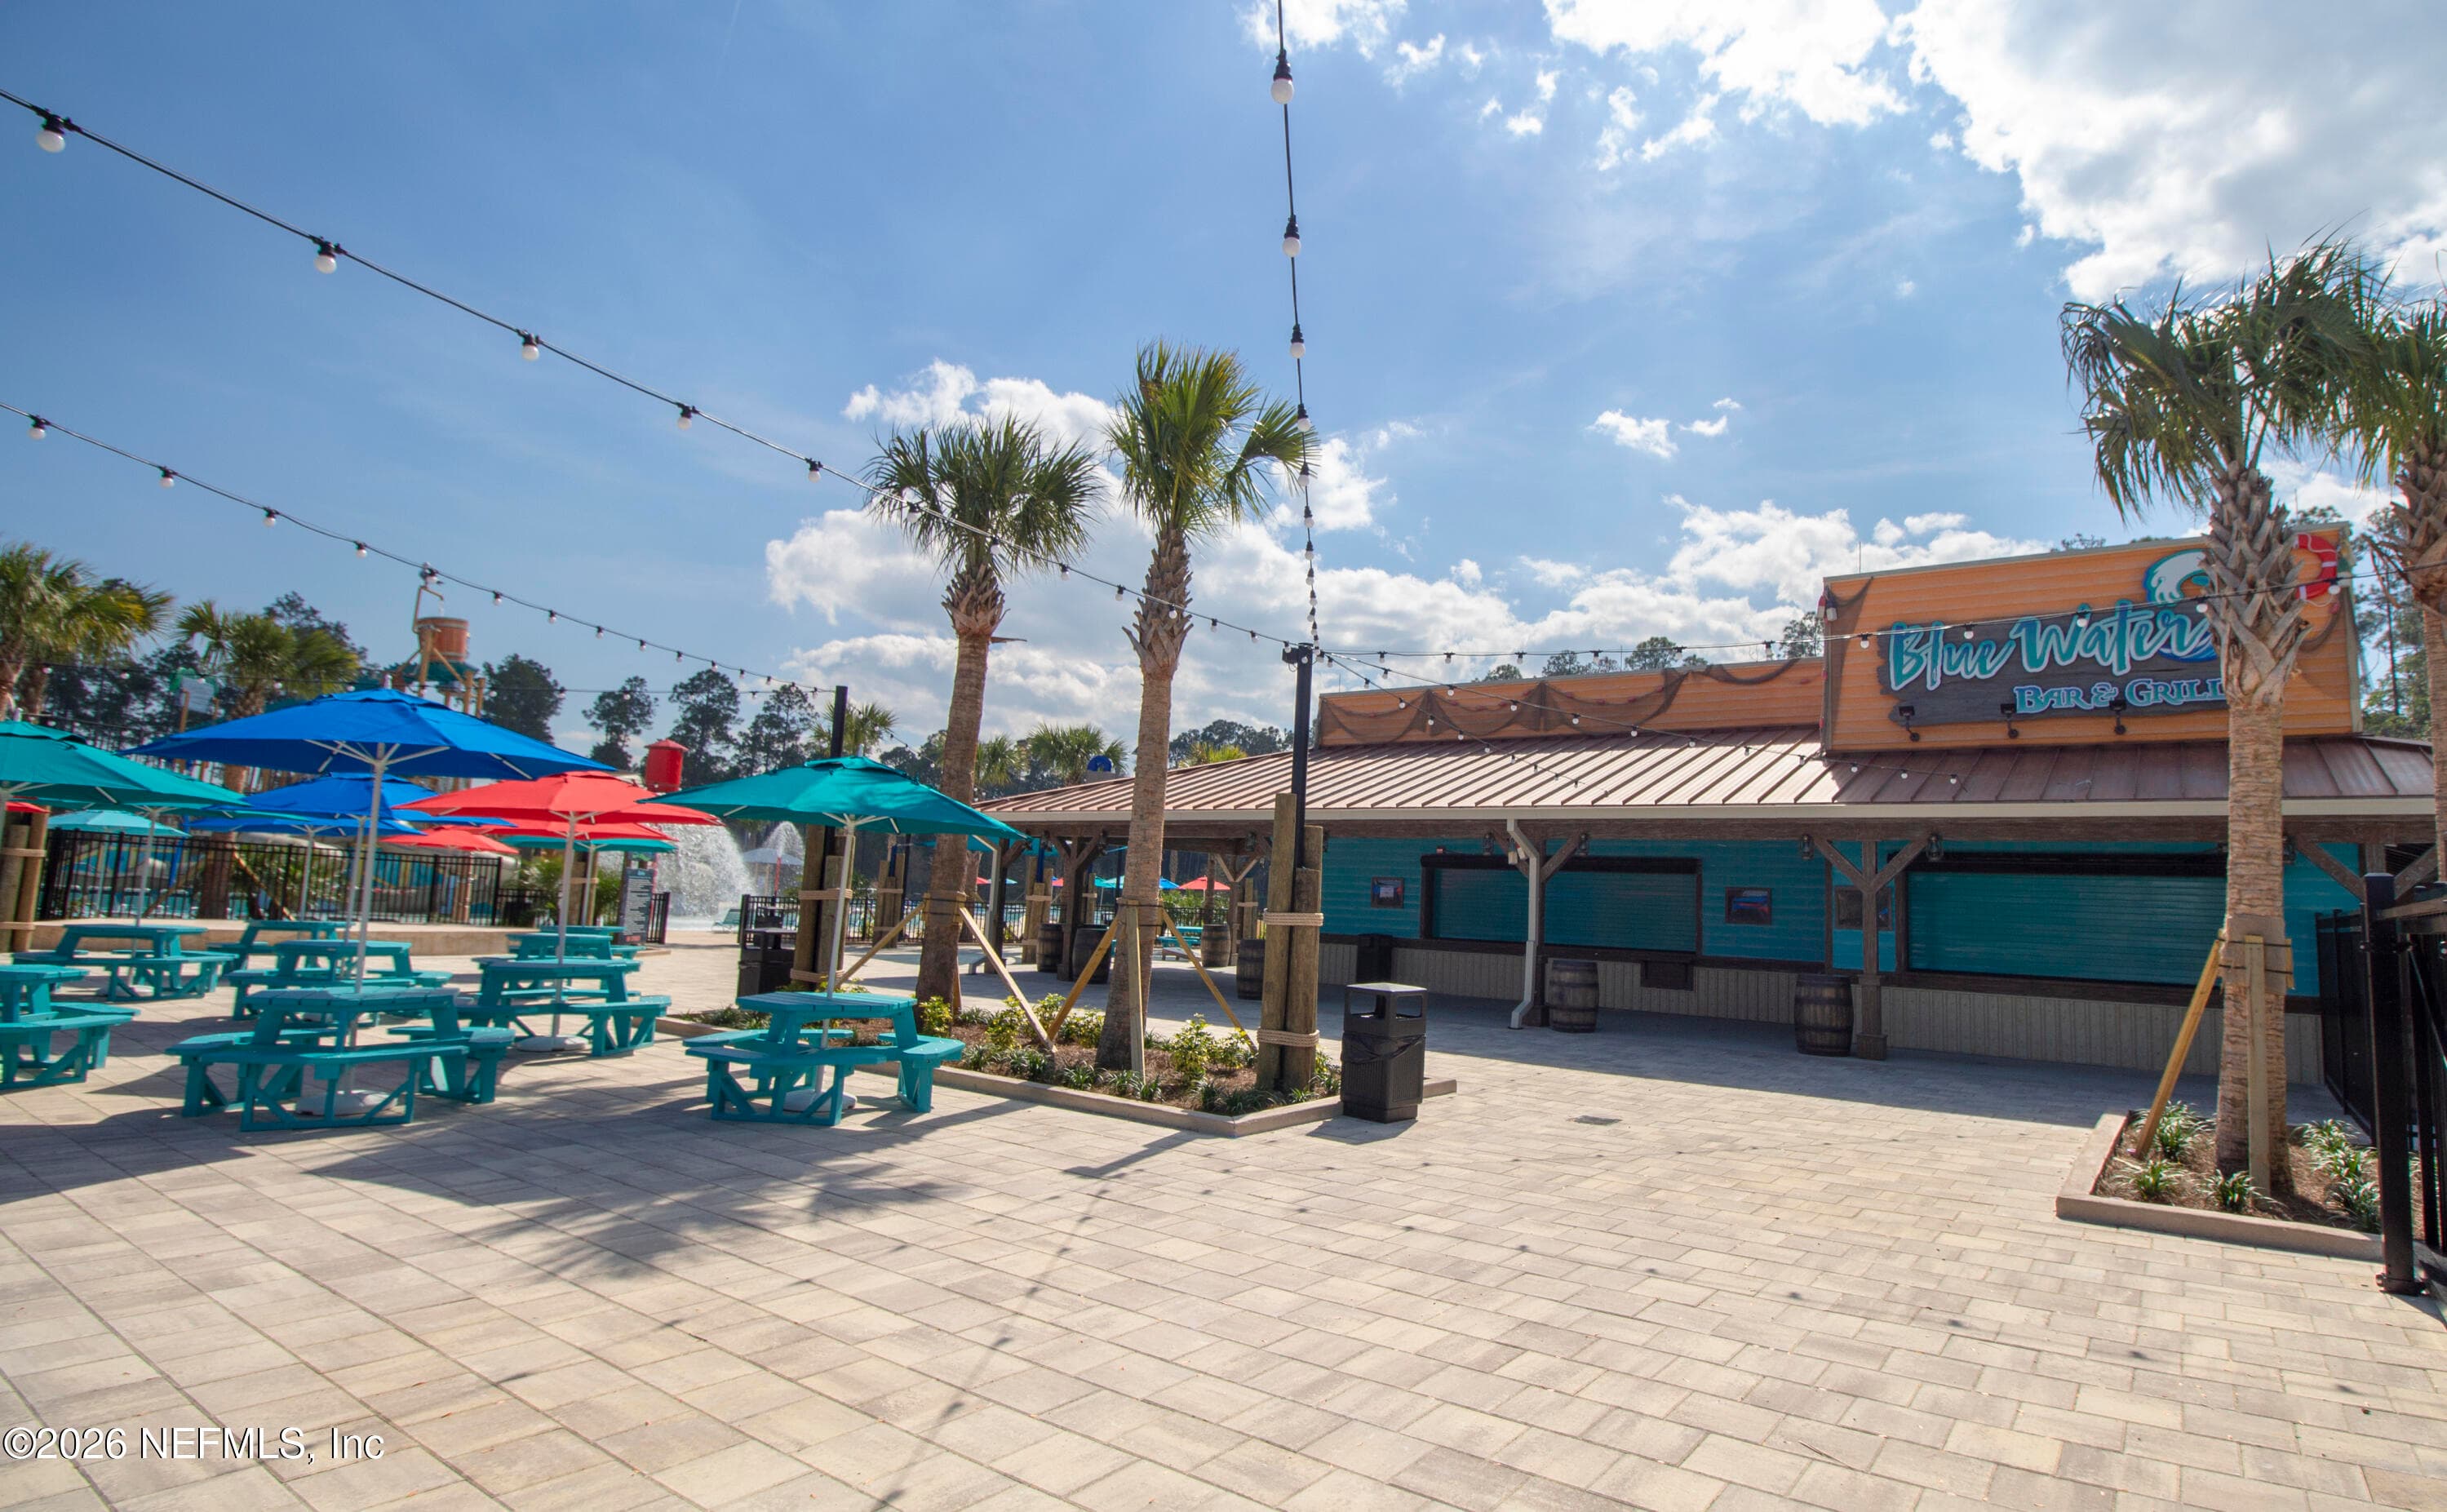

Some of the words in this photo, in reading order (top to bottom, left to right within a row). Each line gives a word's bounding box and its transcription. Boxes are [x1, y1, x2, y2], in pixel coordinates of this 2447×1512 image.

[1889, 620, 2016, 691] Blue
[2013, 685, 2094, 714] BAR
[2090, 681, 2120, 709] &
